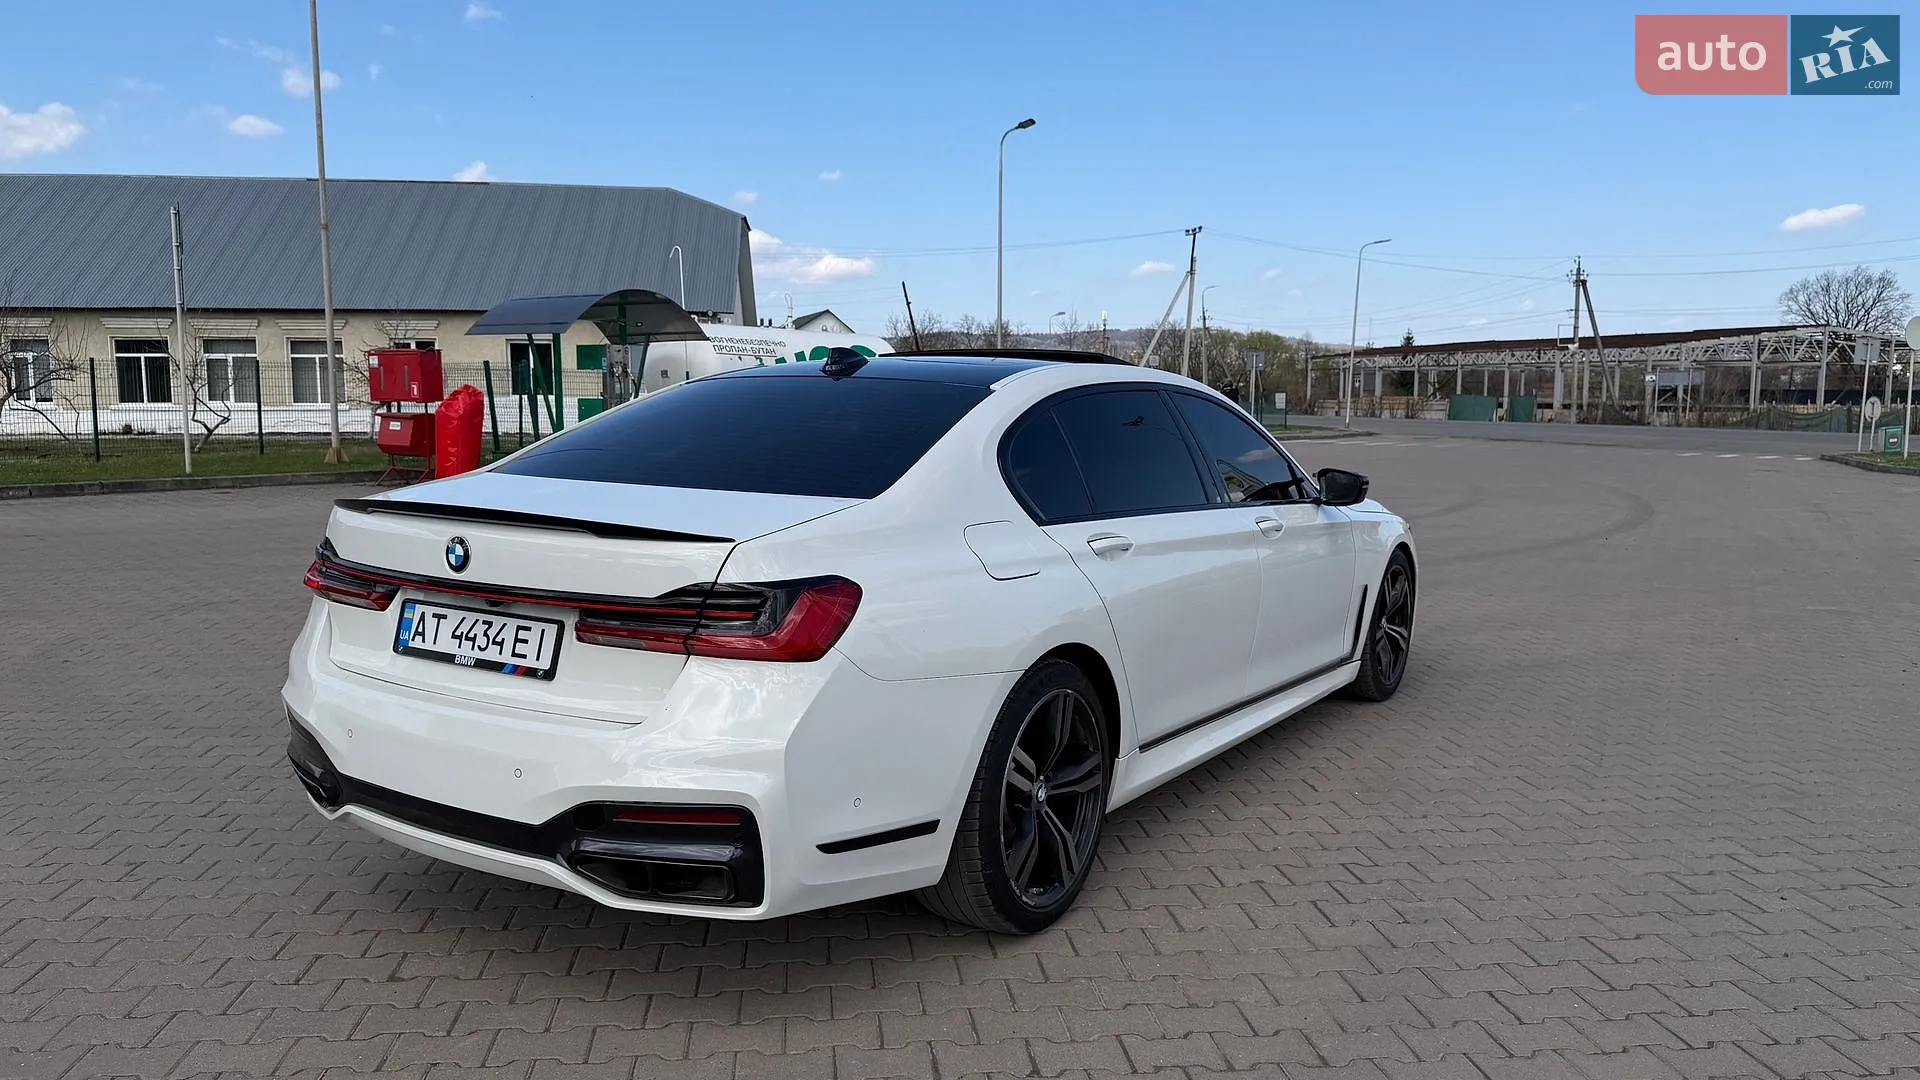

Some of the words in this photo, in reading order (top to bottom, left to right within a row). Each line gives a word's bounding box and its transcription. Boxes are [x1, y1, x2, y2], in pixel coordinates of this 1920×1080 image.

[713, 344, 776, 355] ПРОПАН-БУТАН
[400, 629, 409, 641] UA
[411, 611, 448, 645] AT
[451, 616, 508, 656] 4434
[511, 625, 546, 662] EI
[454, 654, 476, 667] BMW
